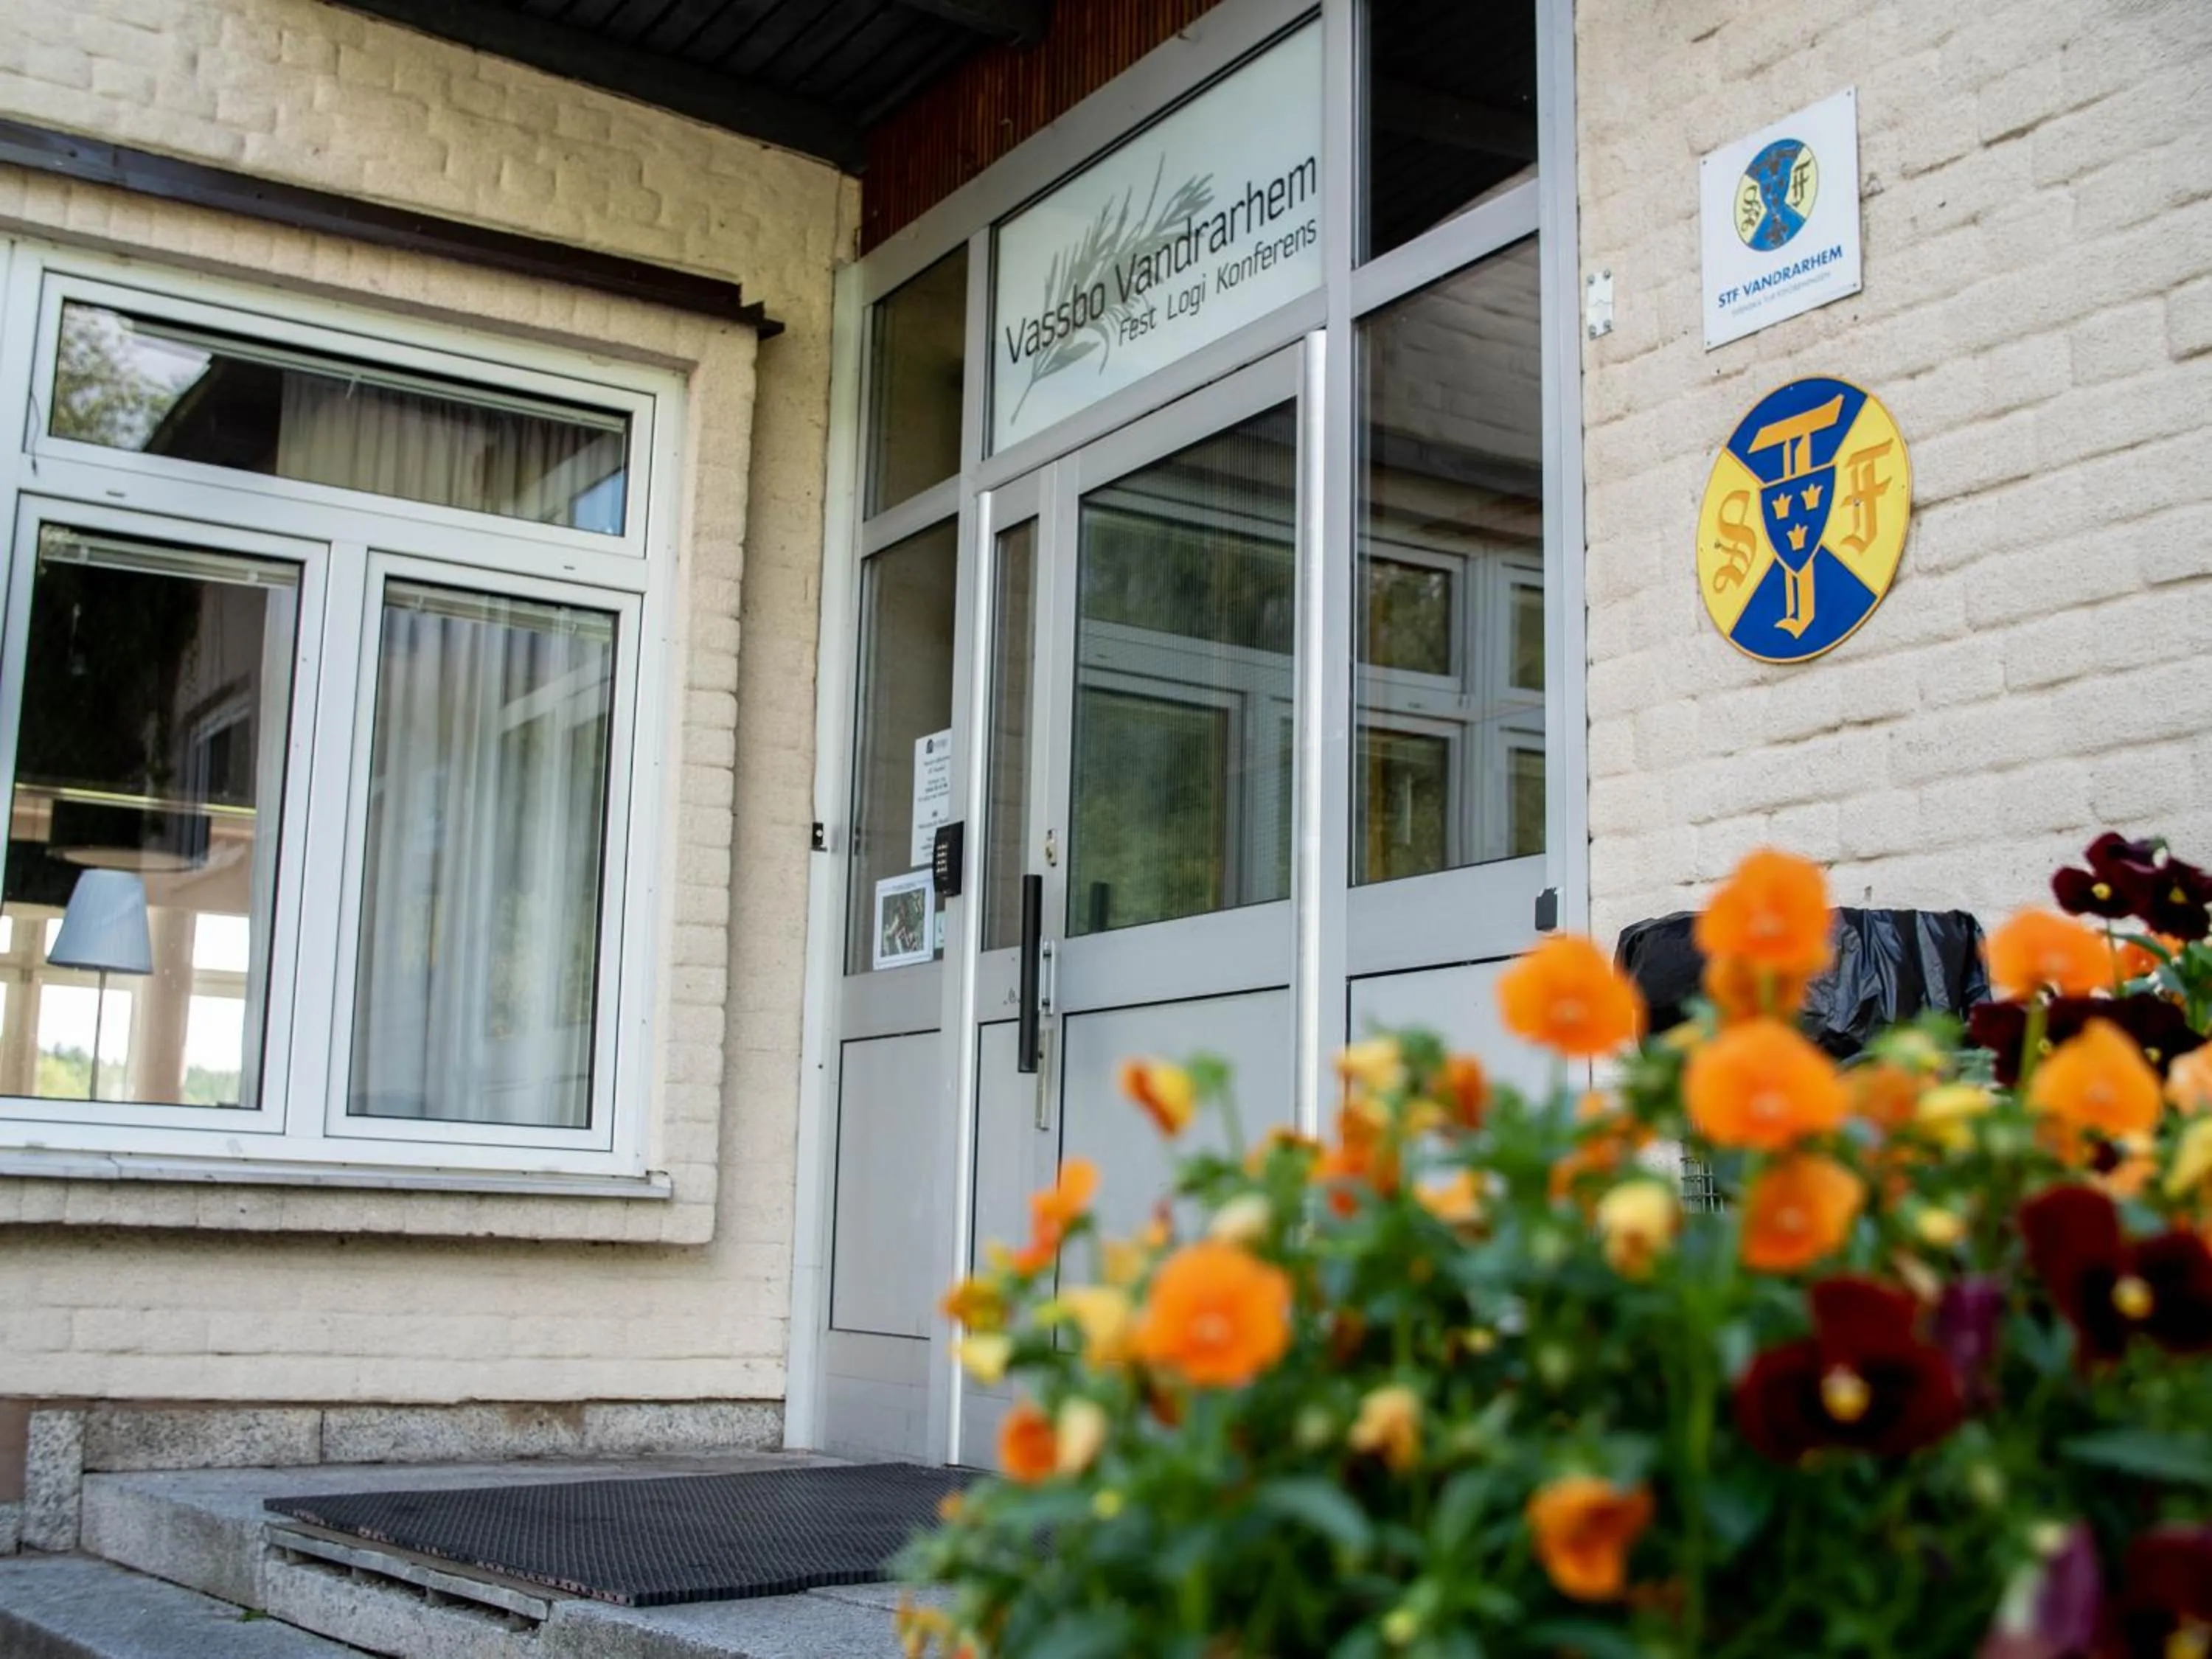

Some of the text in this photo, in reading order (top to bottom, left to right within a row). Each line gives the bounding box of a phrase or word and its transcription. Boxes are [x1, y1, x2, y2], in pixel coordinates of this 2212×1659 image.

[1005, 155, 1318, 365] Vassbo Vandrarhem
[1119, 219, 1318, 347] Fest Logi Konferens
[1718, 288, 1739, 308] STF
[1742, 244, 1843, 297] VANDRARHEM
